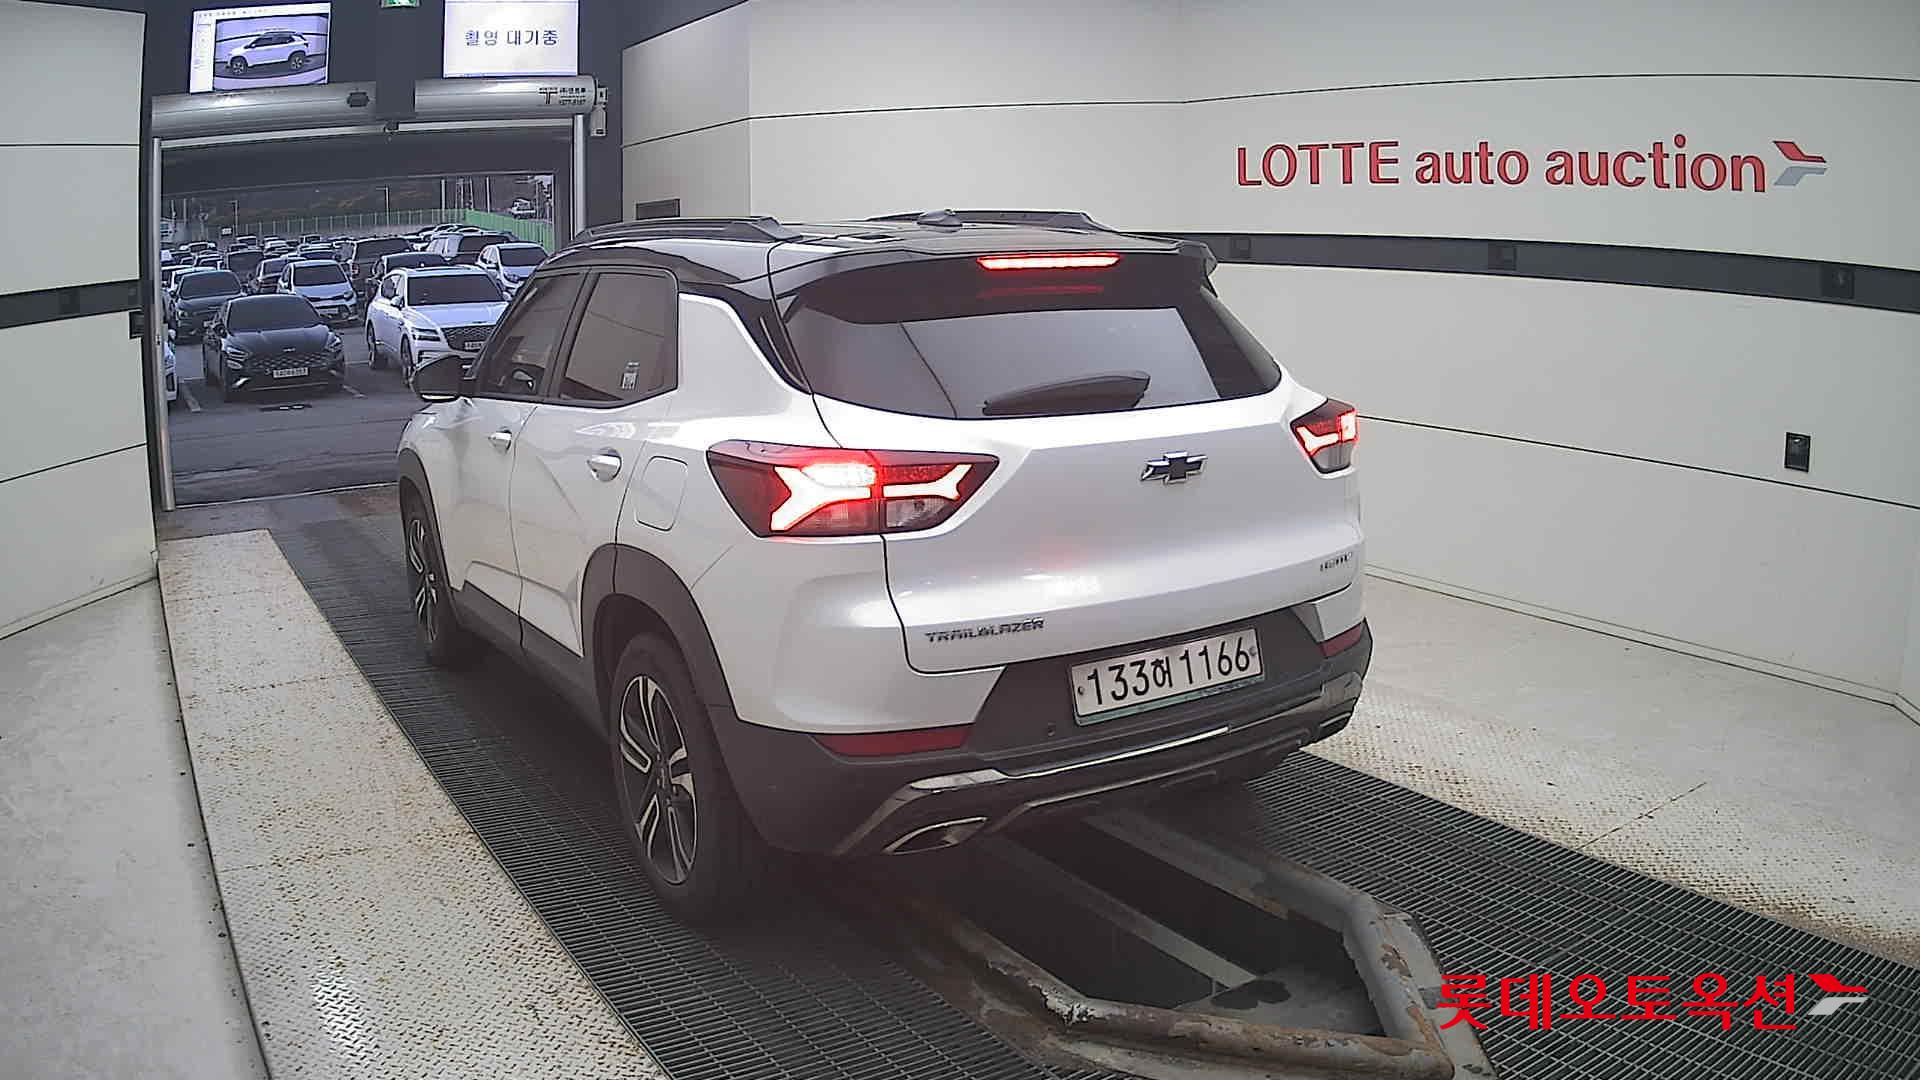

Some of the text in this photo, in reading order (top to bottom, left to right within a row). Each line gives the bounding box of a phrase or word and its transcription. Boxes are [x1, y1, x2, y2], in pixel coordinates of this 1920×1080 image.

[506, 29, 559, 46] 대기중
[1236, 135, 1767, 192] LOTTE auto auction
[925, 616, 1045, 642] TRAILBLAZER
